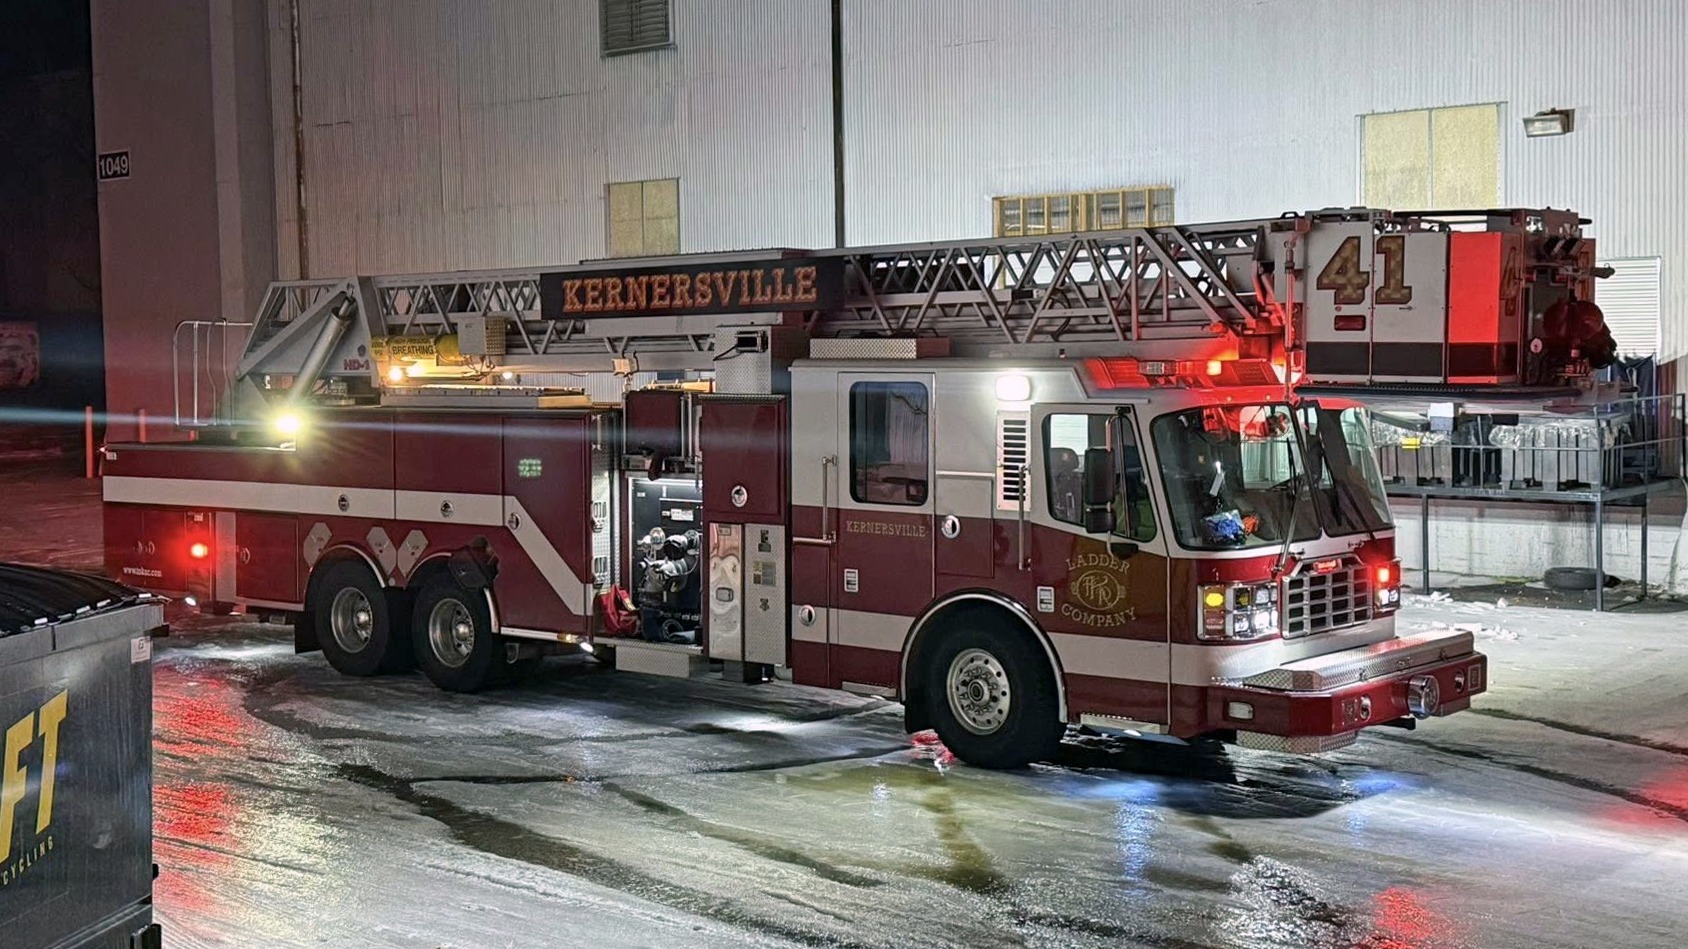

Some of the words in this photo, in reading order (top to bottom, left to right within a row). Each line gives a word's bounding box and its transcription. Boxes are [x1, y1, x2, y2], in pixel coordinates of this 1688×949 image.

[100, 155, 128, 177] 1049
[1316, 235, 1412, 305] 41
[562, 265, 818, 313] KERNERSVILLE
[392, 344, 434, 356] BREATHING
[846, 520, 926, 538] KERNERSVILLE
[1065, 553, 1130, 575] LADDER
[1061, 603, 1136, 627] COMPANY
[0, 835, 54, 886] CYCLING
